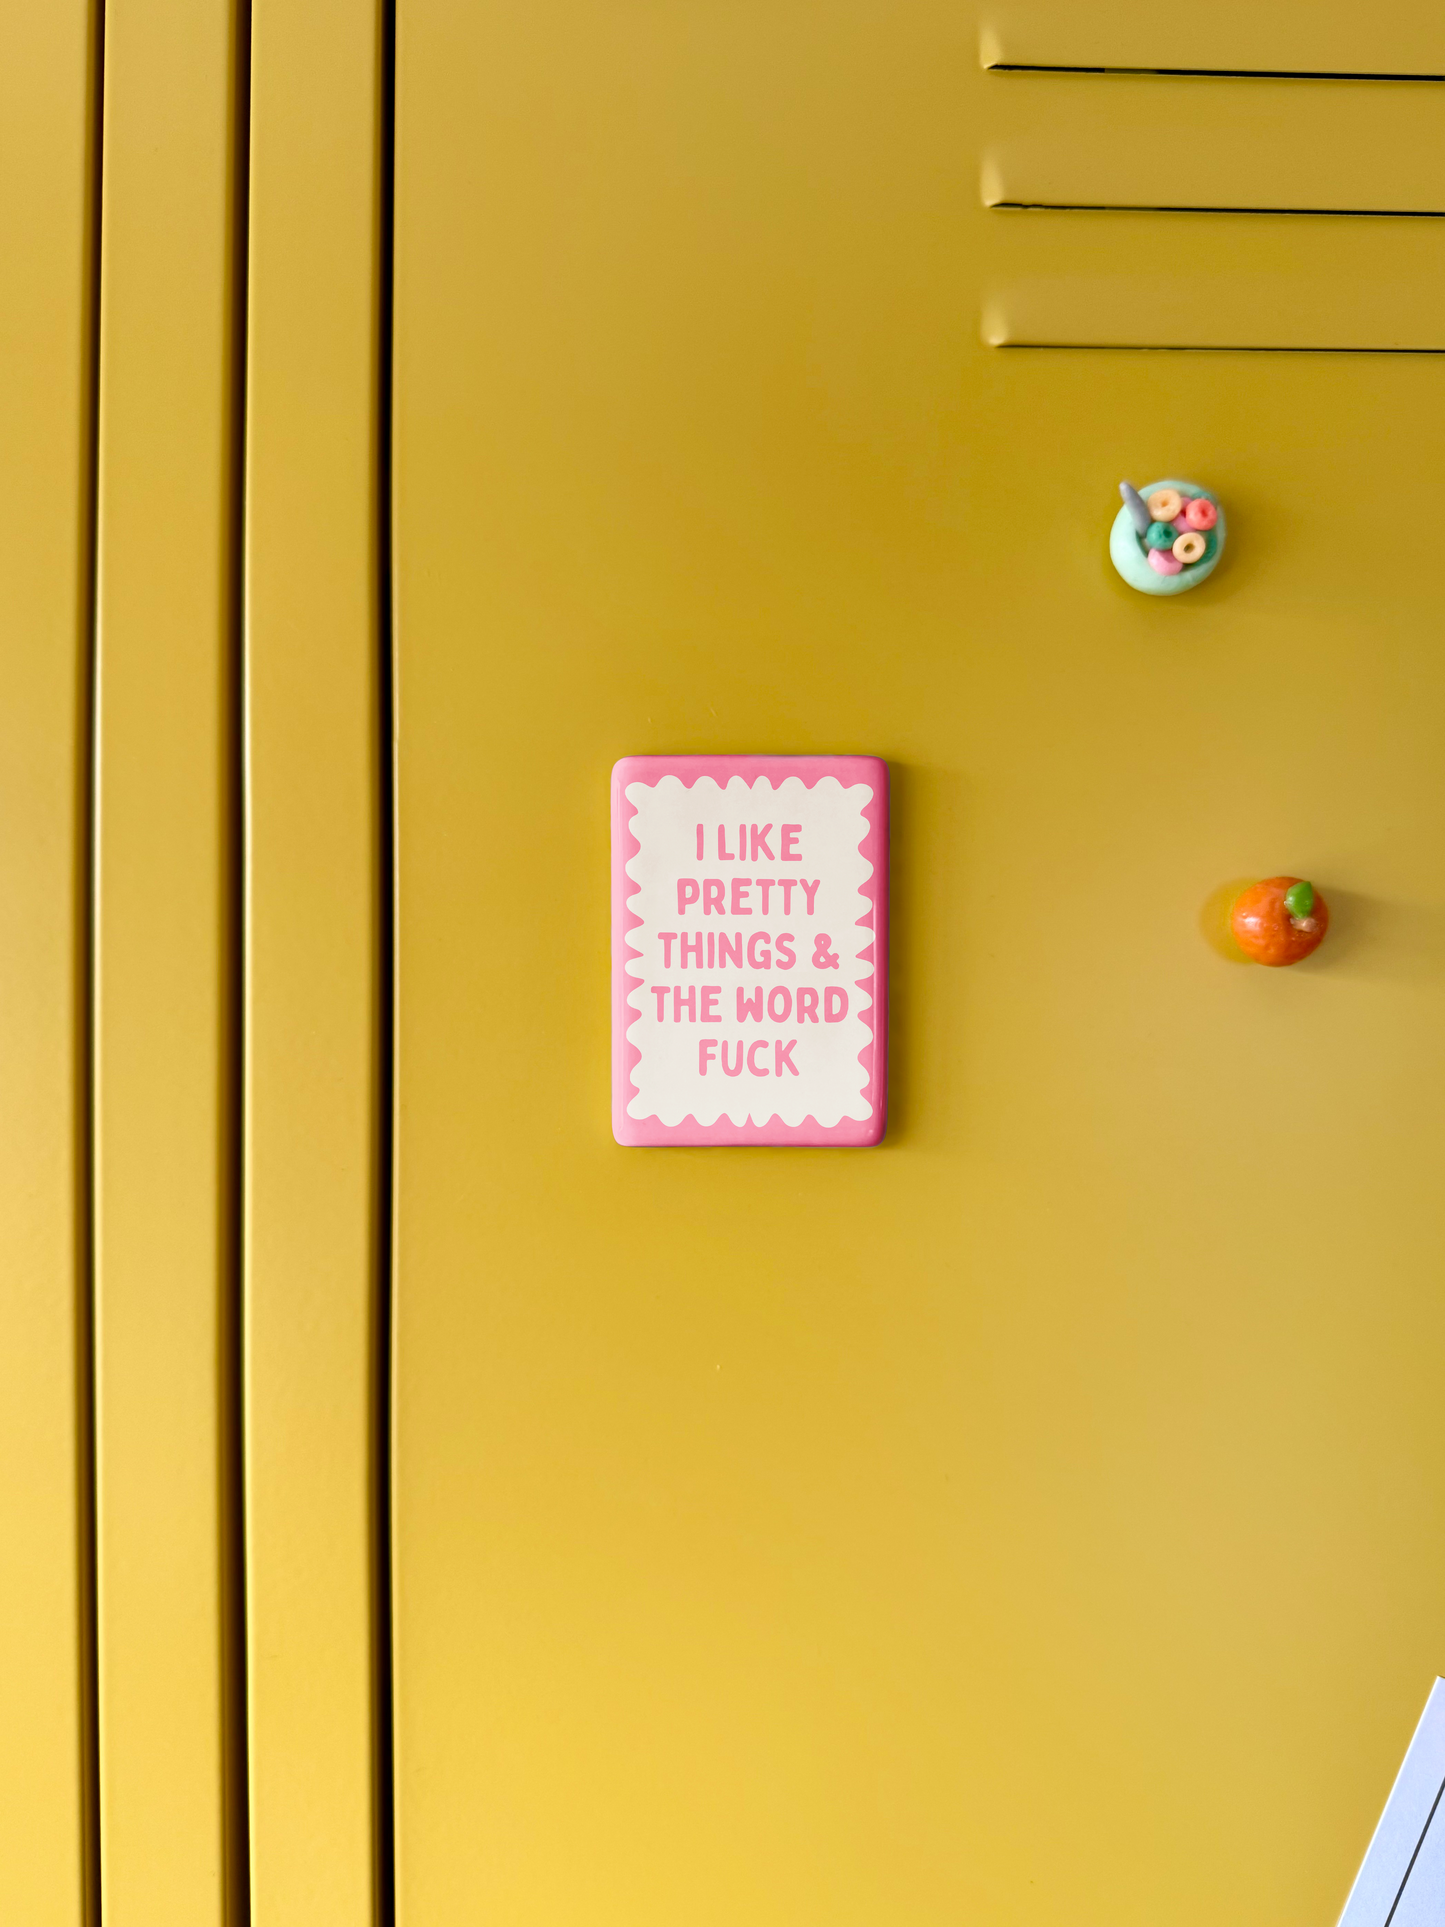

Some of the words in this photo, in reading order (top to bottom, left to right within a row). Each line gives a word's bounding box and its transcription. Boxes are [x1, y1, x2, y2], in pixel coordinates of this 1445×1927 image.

[696, 823, 705, 862] I
[717, 823, 803, 862] LIKE
[676, 877, 821, 916] PRETTY
[657, 931, 797, 970] THINGS
[811, 932, 840, 970] &
[650, 985, 723, 1024] THE
[735, 985, 850, 1024] WORD
[698, 1038, 800, 1078] FUCK
